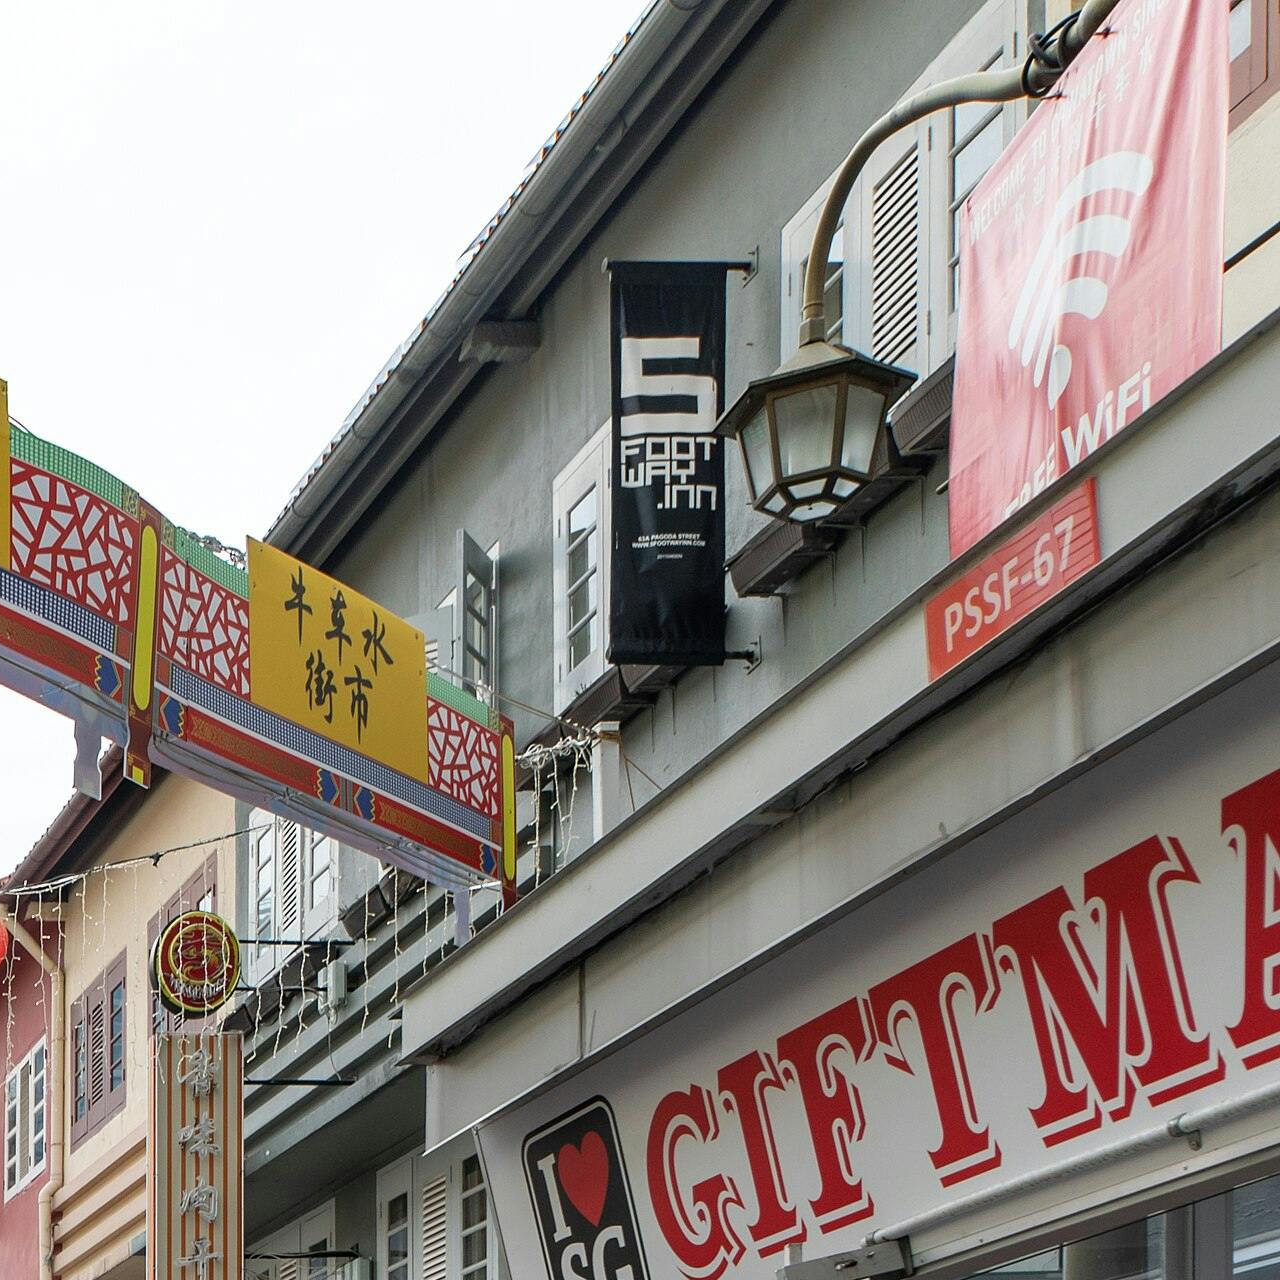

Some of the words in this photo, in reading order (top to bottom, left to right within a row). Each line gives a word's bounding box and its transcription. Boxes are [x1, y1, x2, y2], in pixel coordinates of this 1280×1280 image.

[621, 336, 717, 434] 5
[1061, 361, 1152, 468] WiFi
[621, 437, 717, 461] FOOT
[621, 461, 696, 488] WAY
[651, 532, 677, 541] PAGODA
[943, 517, 1077, 654] PSSF-67
[305, 649, 374, 745] 街市
[536, 1152, 572, 1238] I
